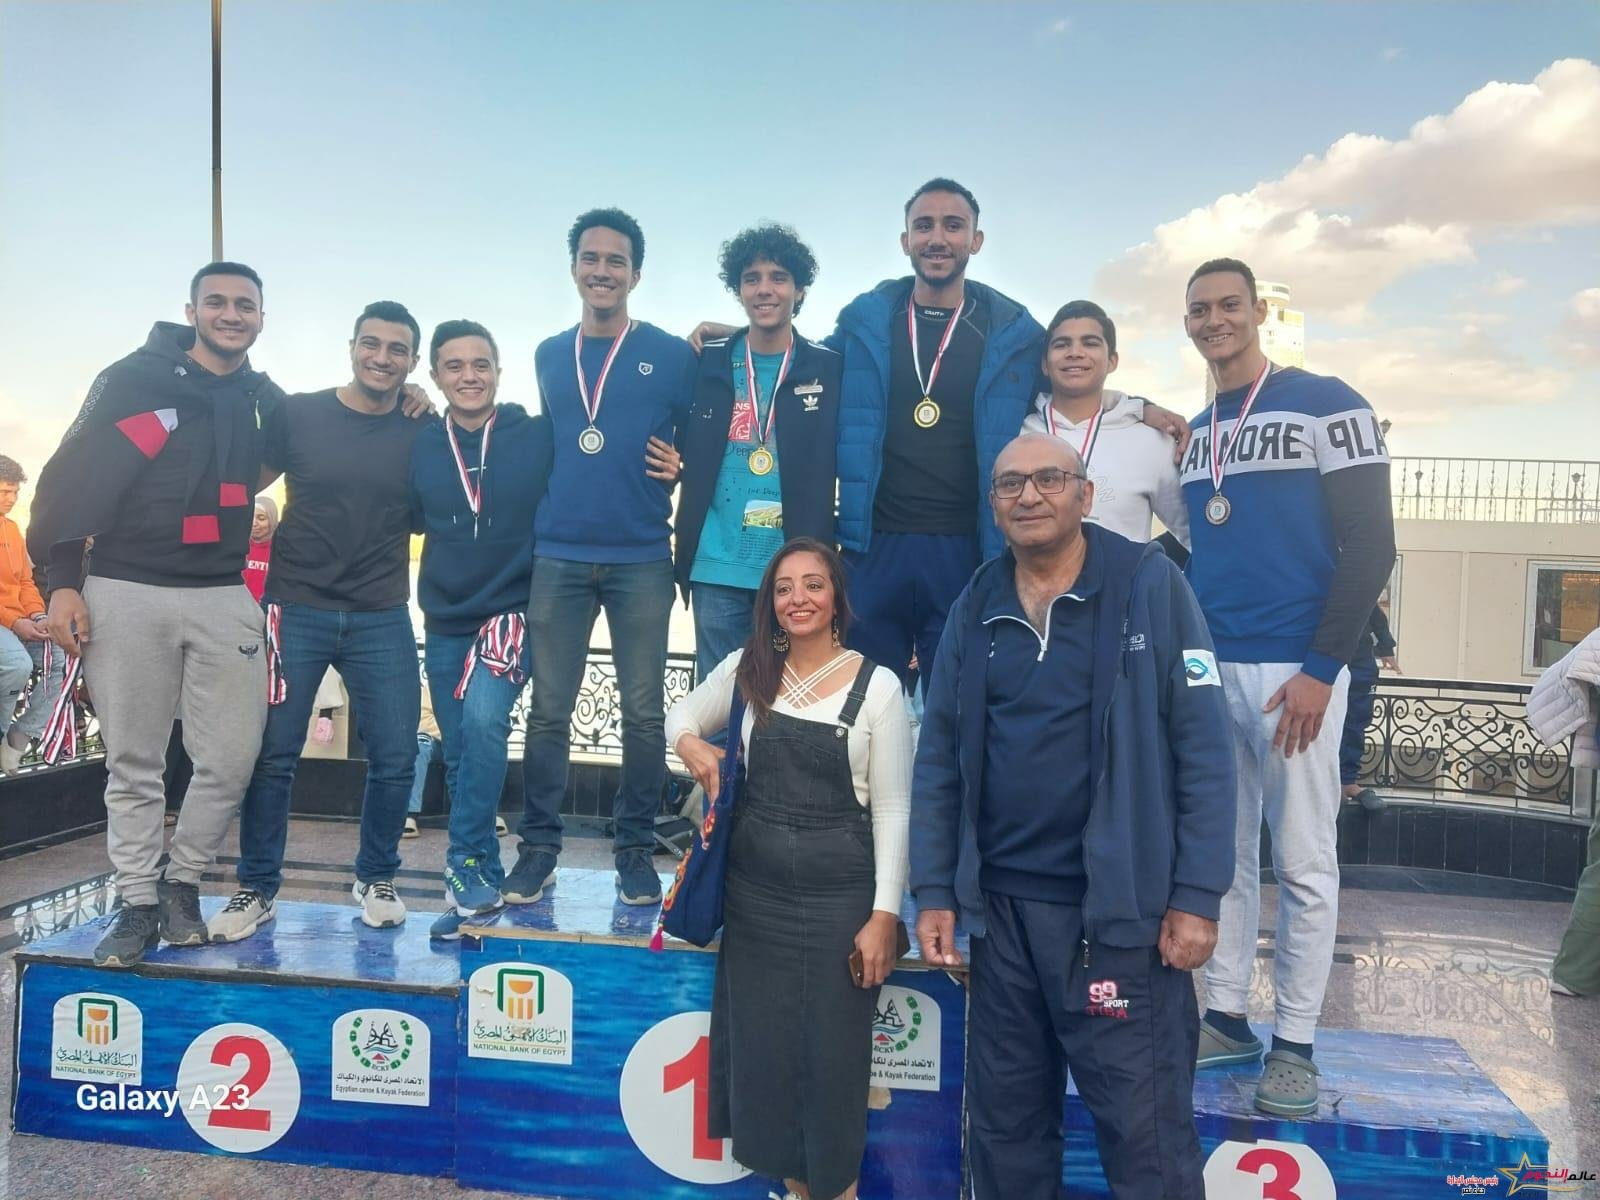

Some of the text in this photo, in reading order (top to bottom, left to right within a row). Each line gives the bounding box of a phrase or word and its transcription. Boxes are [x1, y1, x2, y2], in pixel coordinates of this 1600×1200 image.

[733, 403, 750, 411] NS
[1180, 422, 1304, 475] AYMORE
[1089, 981, 1117, 1003] 99
[1103, 999, 1129, 1008] SPORT
[473, 1043, 507, 1052] NATIONAL
[542, 1048, 567, 1057] EGYPT
[55, 1066, 86, 1074] NATIONAL
[115, 1071, 136, 1079] EGYPT
[878, 1070, 883, 1078] &
[884, 1070, 903, 1080] Kayak
[904, 1071, 936, 1081] Federation
[207, 1035, 271, 1132] 2
[336, 1084, 358, 1094] Egyptian
[381, 1087, 397, 1097] Kayak
[398, 1088, 426, 1097] Federation
